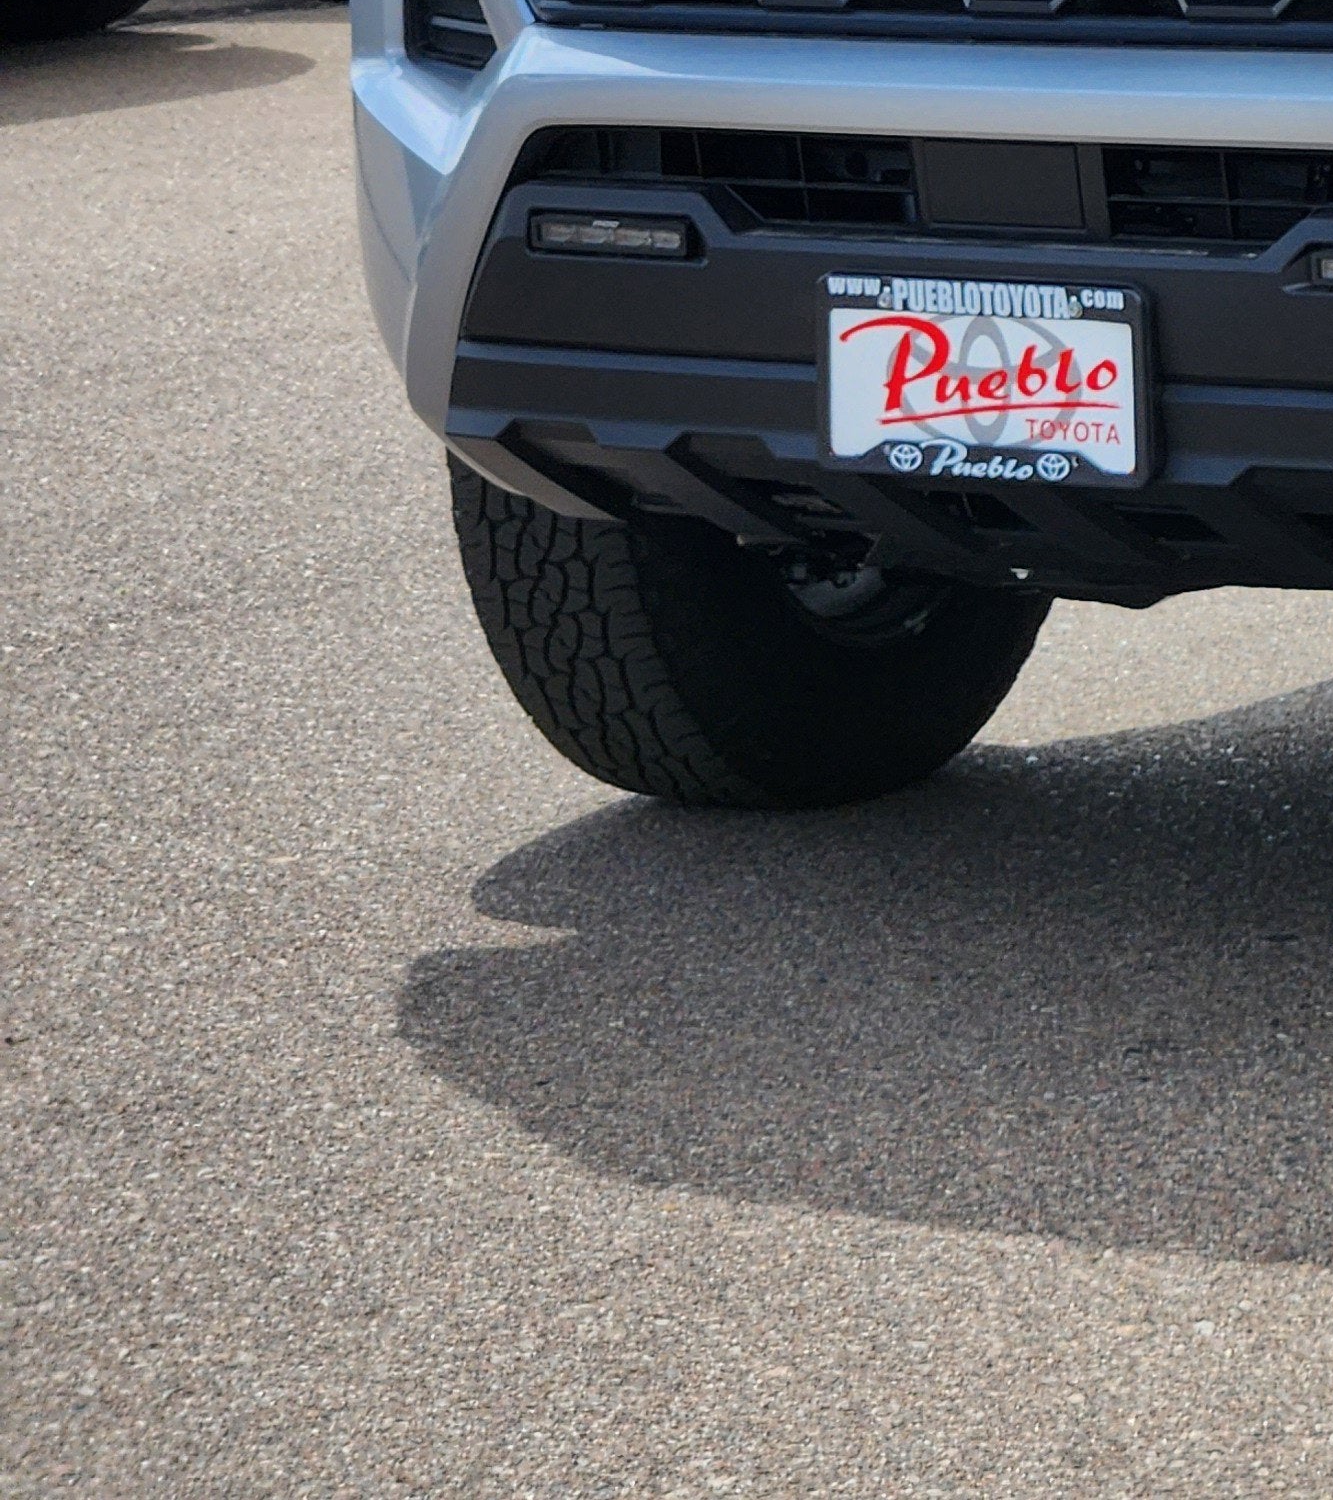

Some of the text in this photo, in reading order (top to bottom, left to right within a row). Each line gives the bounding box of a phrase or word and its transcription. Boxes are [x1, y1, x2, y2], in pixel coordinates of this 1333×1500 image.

[840, 315, 1118, 412] Pueblo
[1025, 418, 1121, 446] TOYOTA
[921, 438, 1034, 482] Pueblo
